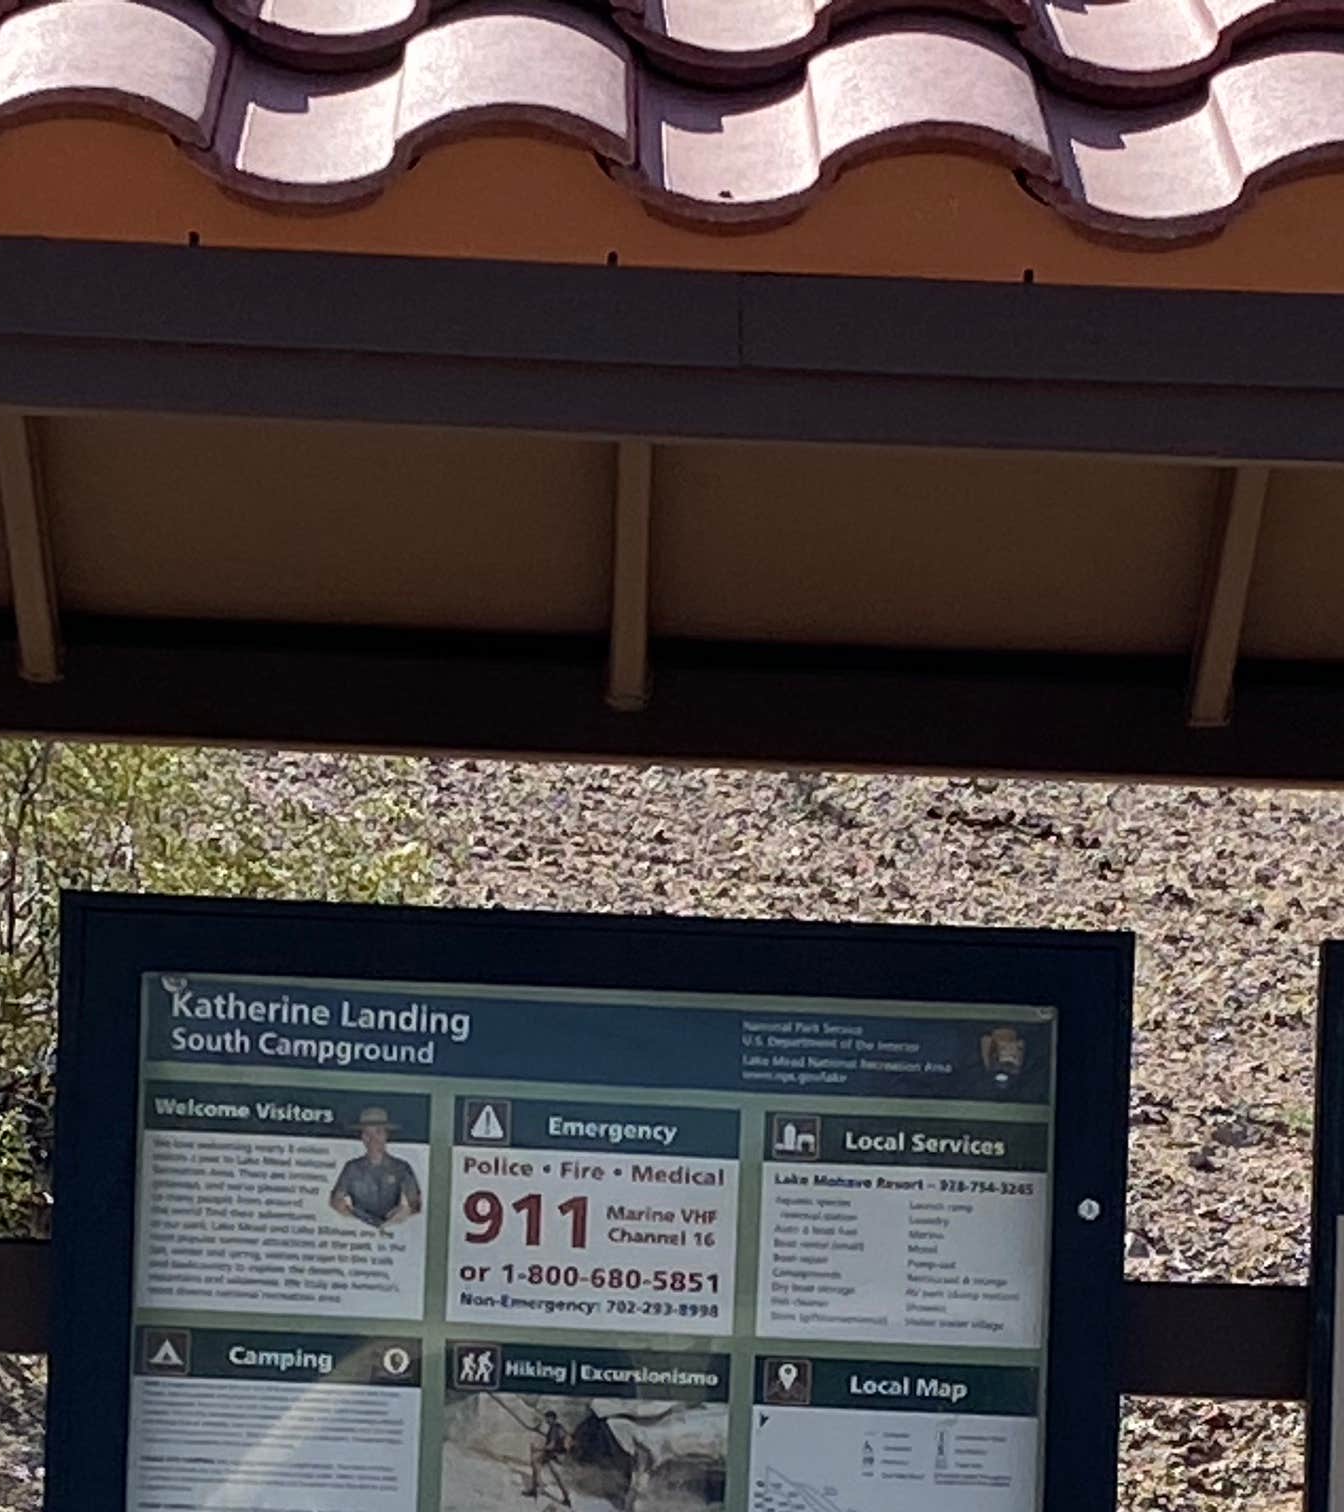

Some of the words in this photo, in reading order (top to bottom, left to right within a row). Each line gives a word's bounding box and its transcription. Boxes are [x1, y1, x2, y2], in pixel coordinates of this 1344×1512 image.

[171, 990, 330, 1026] Katherine
[341, 1001, 470, 1042] Landing
[171, 1027, 250, 1053] South
[259, 1032, 434, 1065] Campground
[768, 1036, 836, 1050] Department
[742, 1056, 768, 1066] Lake
[772, 1057, 804, 1068] Mead
[155, 1098, 250, 1119] Welcome
[256, 1103, 334, 1124] Visitors
[548, 1117, 677, 1144] Emergency
[846, 1132, 905, 1150] Local
[911, 1134, 1005, 1156] Services
[464, 1157, 534, 1177] Police
[560, 1161, 604, 1180] Fire
[632, 1165, 724, 1186] Medical
[464, 1191, 589, 1249] 911
[607, 1206, 675, 1223] Marine
[680, 1209, 717, 1224] VHF
[608, 1228, 686, 1245] Channel
[694, 1232, 715, 1246] 16
[460, 1265, 490, 1281] or
[502, 1263, 719, 1293] 1-800-680-5851
[229, 1346, 333, 1373] Camping
[506, 1360, 566, 1383] Hiking
[581, 1363, 718, 1386] Excursionismo
[850, 1376, 908, 1396] Local
[916, 1379, 967, 1402] Map
